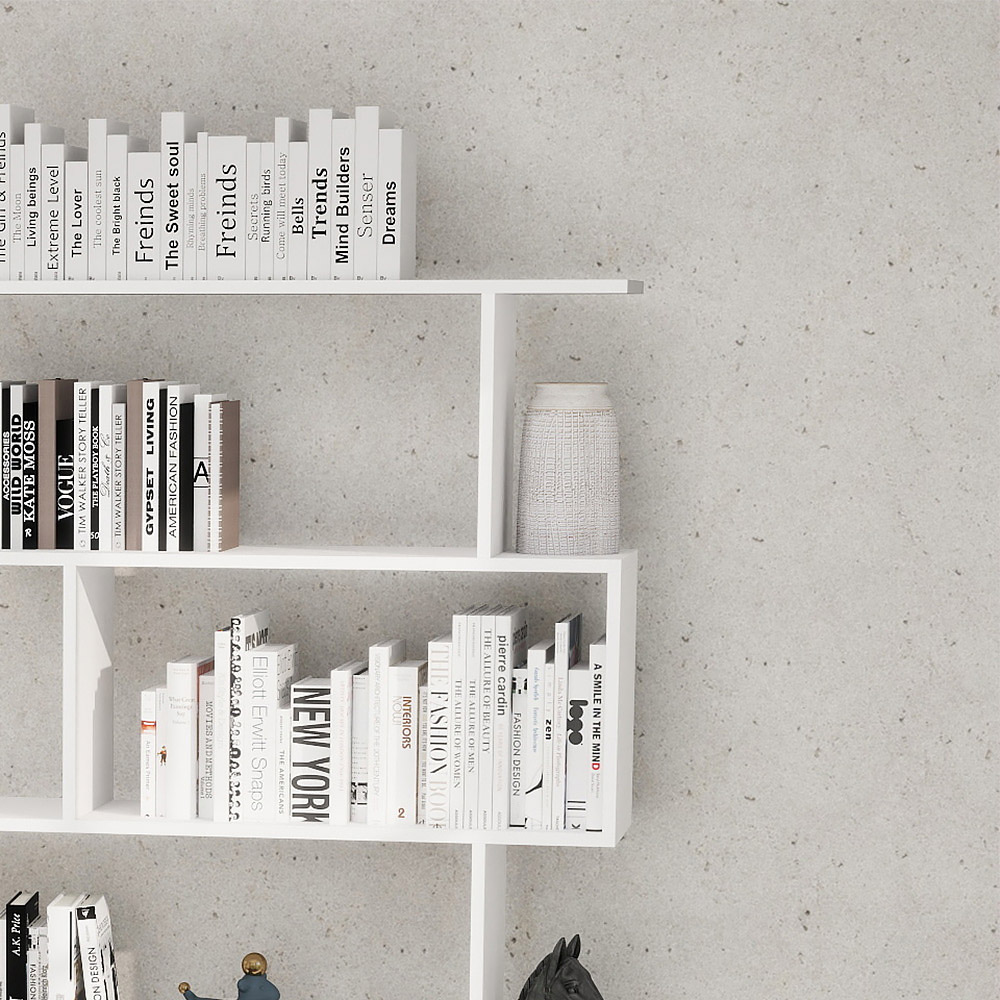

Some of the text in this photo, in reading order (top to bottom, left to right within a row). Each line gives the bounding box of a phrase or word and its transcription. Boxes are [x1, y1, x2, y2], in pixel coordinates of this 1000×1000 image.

[13, 193, 22, 243] The Moon
[27, 168, 39, 247] Living beings
[47, 166, 59, 270] Extreme Level
[72, 189, 82, 258] The Lover
[112, 177, 122, 255] The Bright black
[134, 179, 154, 263] Freinds
[166, 142, 179, 270] The Sweet soul
[186, 215, 196, 248] Rhyming
[216, 164, 237, 257] Freinds
[248, 194, 259, 241] Secrets
[261, 169, 272, 243] Running birds
[277, 152, 288, 260] Come will meet today
[292, 197, 304, 235] Bells
[312, 168, 328, 239] Trends
[336, 147, 350, 263] Mind Builders
[357, 173, 373, 237] Senser
[382, 181, 396, 244] Dreams
[93, 229, 102, 248] The
[24, 421, 35, 522] KATE MOSS
[58, 455, 74, 521] VOGUE
[79, 388, 87, 533] TIM WALKER STORY TELLER
[146, 399, 154, 535] GYPSET LIVING
[169, 396, 177, 538] AMERICAN FASHION
[194, 461, 209, 483] A
[483, 629, 492, 650] THE
[497, 635, 506, 672] pierre
[252, 656, 268, 699] Elliott
[483, 653, 491, 693] ALLURE
[497, 677, 507, 716] cardin
[593, 674, 602, 704] SMILE
[251, 706, 268, 752] Erwitt
[292, 688, 331, 748] NEW
[402, 696, 412, 749] INTERIORS
[430, 692, 448, 774] FASHION
[482, 712, 491, 754] BEAUTY
[593, 708, 601, 718] IN
[593, 722, 601, 739] THE
[513, 712, 522, 796] FASHION DESIGN
[592, 743, 601, 770] MIND
[251, 757, 268, 811] Snaps
[398, 808, 405, 818] 2
[87, 947, 99, 983] DESIGN
